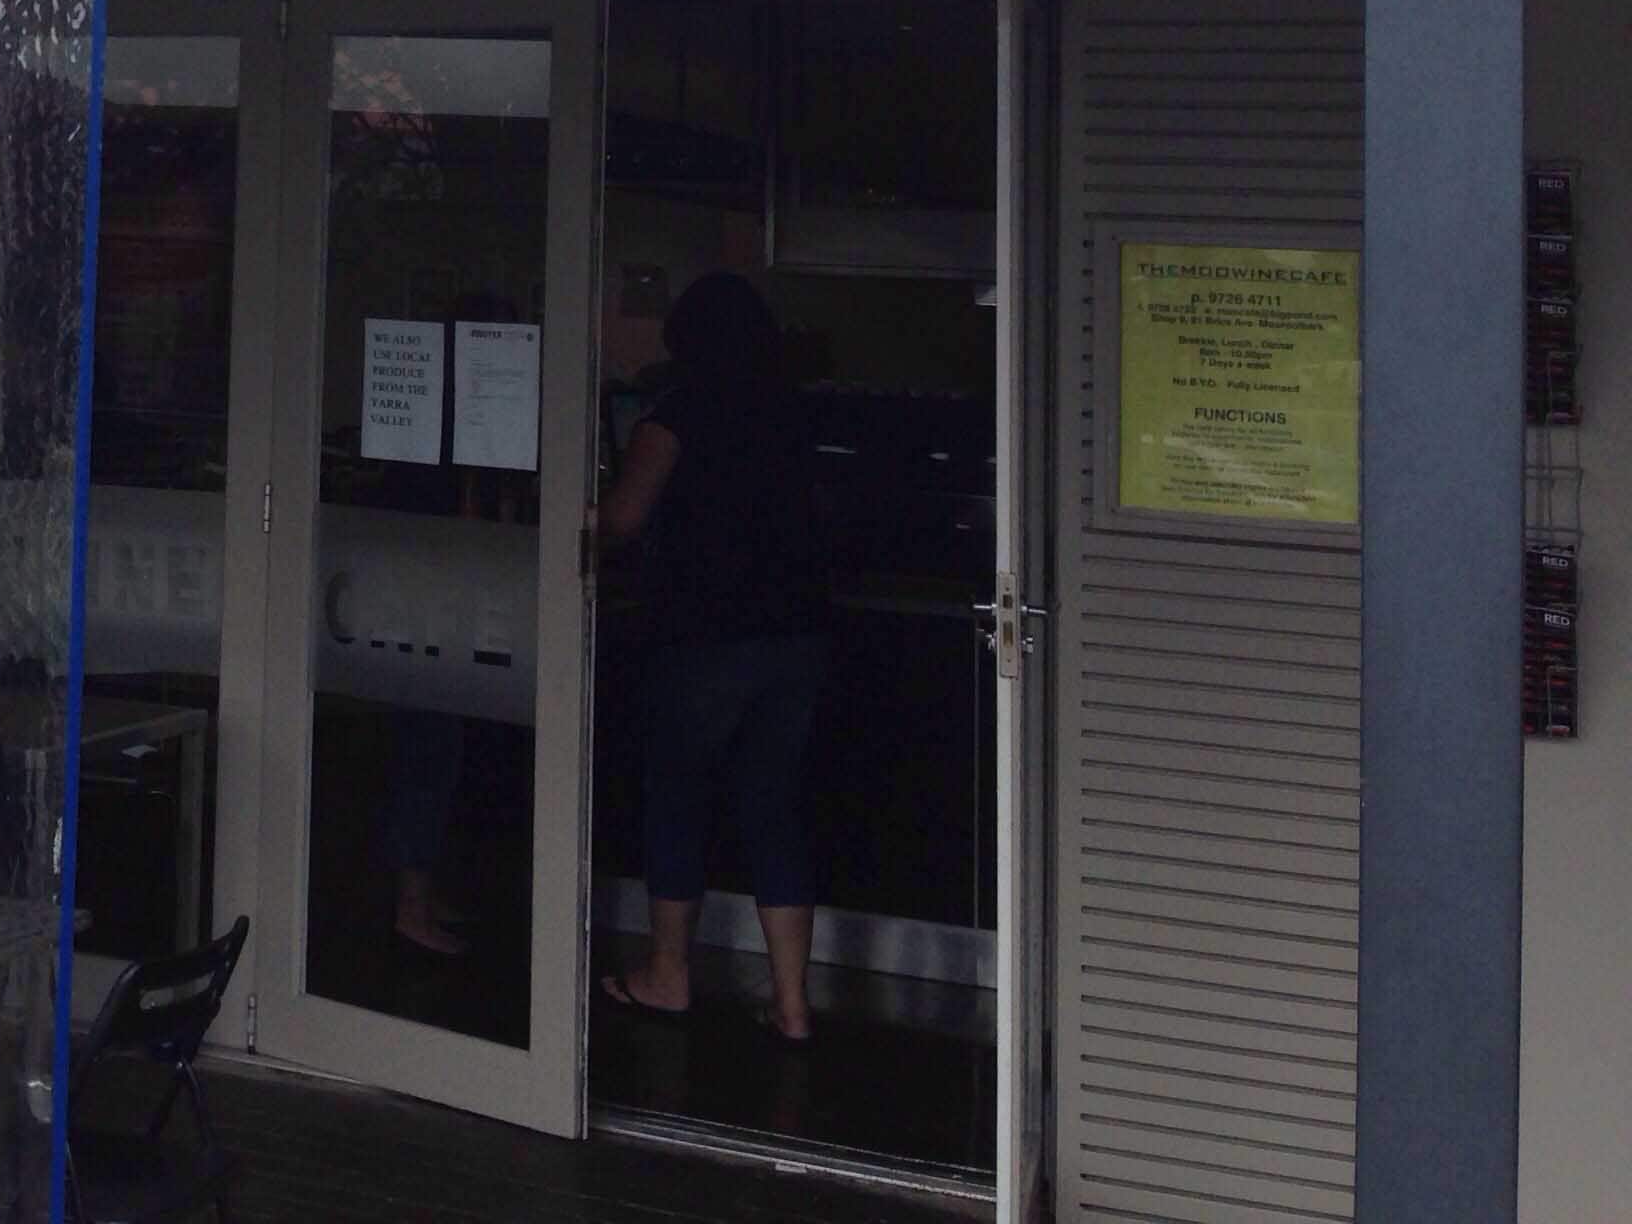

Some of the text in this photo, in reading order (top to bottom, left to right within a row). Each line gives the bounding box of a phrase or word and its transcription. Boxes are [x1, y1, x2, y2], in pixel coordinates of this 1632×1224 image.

[1538, 178, 1565, 189] RED
[1539, 241, 1567, 252] RED
[1541, 304, 1568, 315] RED
[374, 333, 422, 344] WE ALSO
[373, 349, 433, 362] USE LOCAL
[372, 366, 425, 378] PRODUCE
[372, 382, 429, 395] FROM THE
[1253, 381, 1300, 393] Licensed
[371, 398, 411, 409] YARRA
[370, 415, 413, 426] VALLEY
[1194, 407, 1287, 424] FUNCTIONS
[1541, 556, 1569, 568] RED
[1543, 613, 1571, 626] RED
